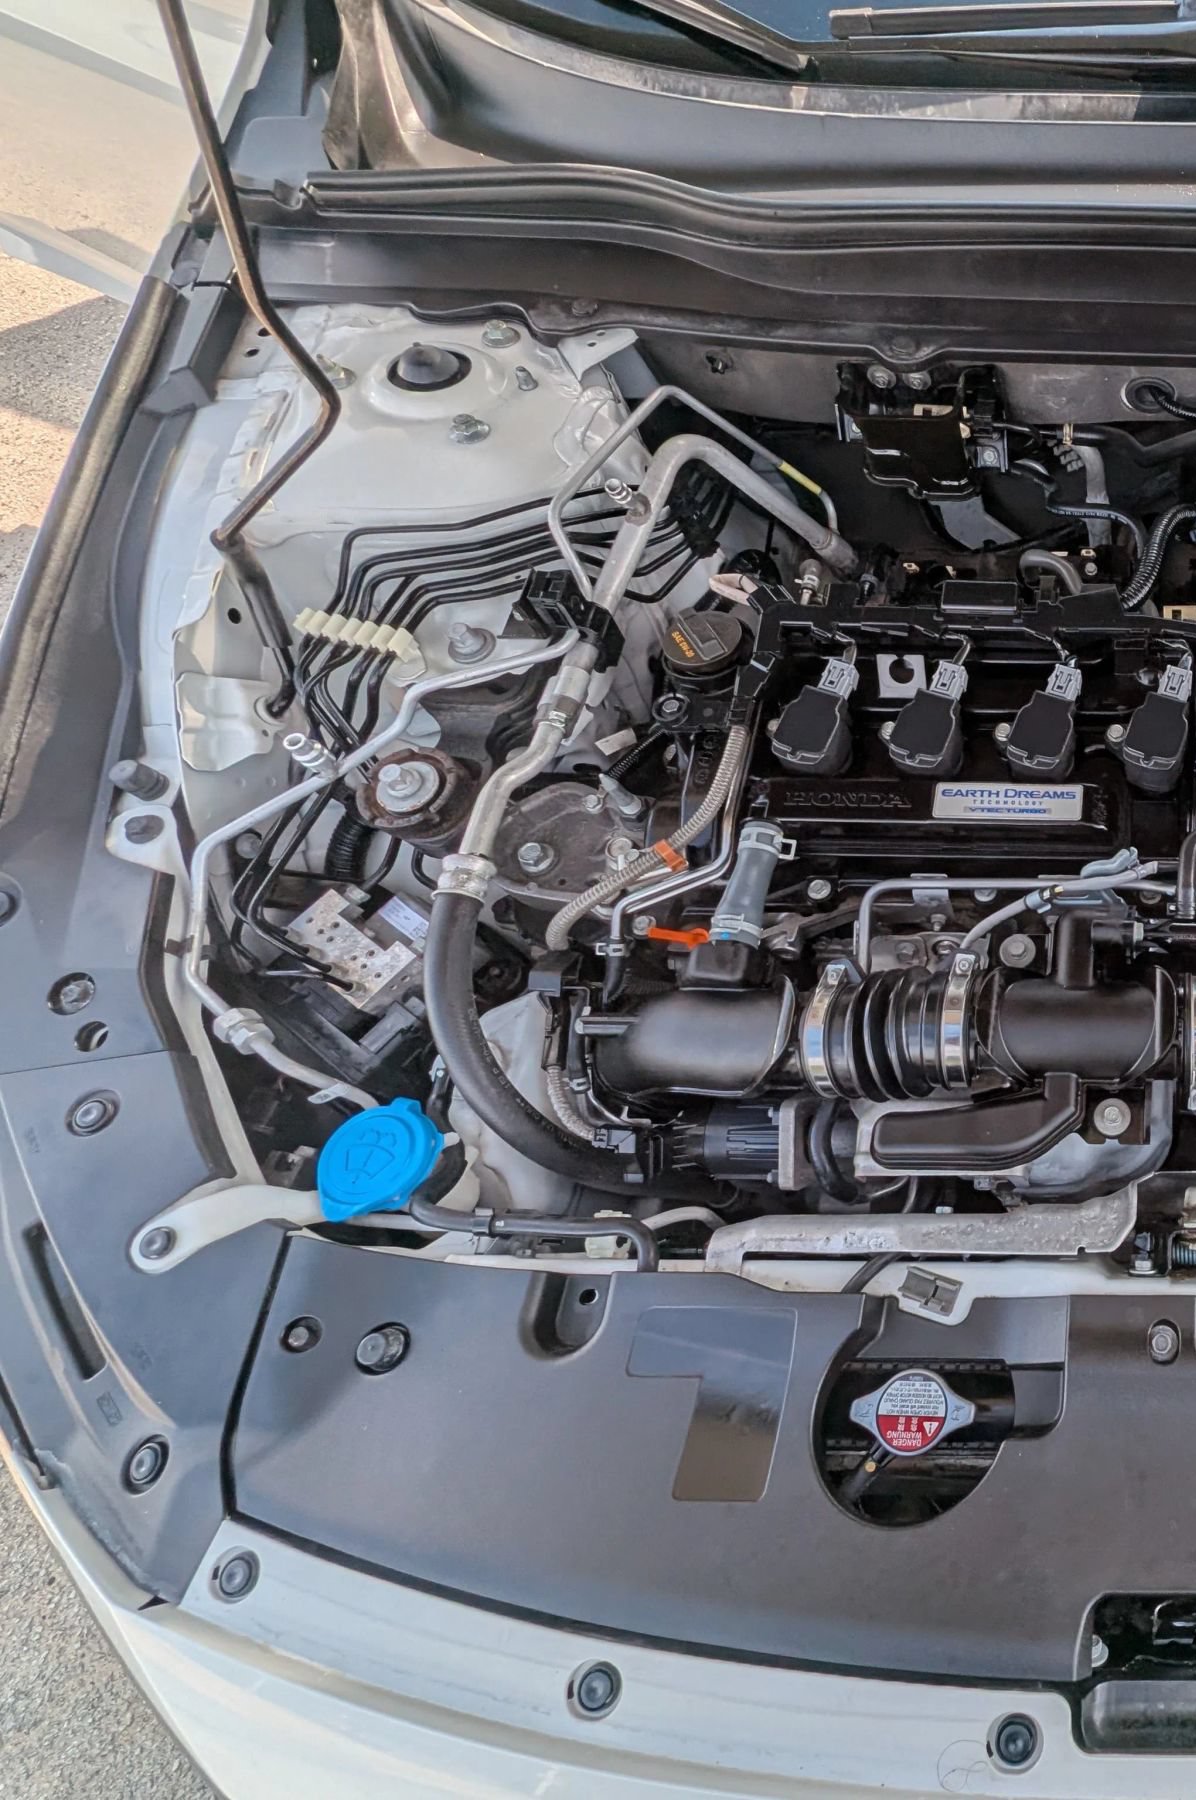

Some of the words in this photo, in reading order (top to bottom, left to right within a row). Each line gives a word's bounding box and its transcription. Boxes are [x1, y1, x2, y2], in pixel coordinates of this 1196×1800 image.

[671, 631, 684, 643] SAE
[679, 641, 695, 657] 0W-20
[941, 789, 999, 797] EARTH
[1004, 789, 1076, 799] DREAMS
[784, 791, 912, 808] HONDA
[886, 1430, 921, 1438] WARNUNG
[892, 1438, 921, 1446] DANGER
